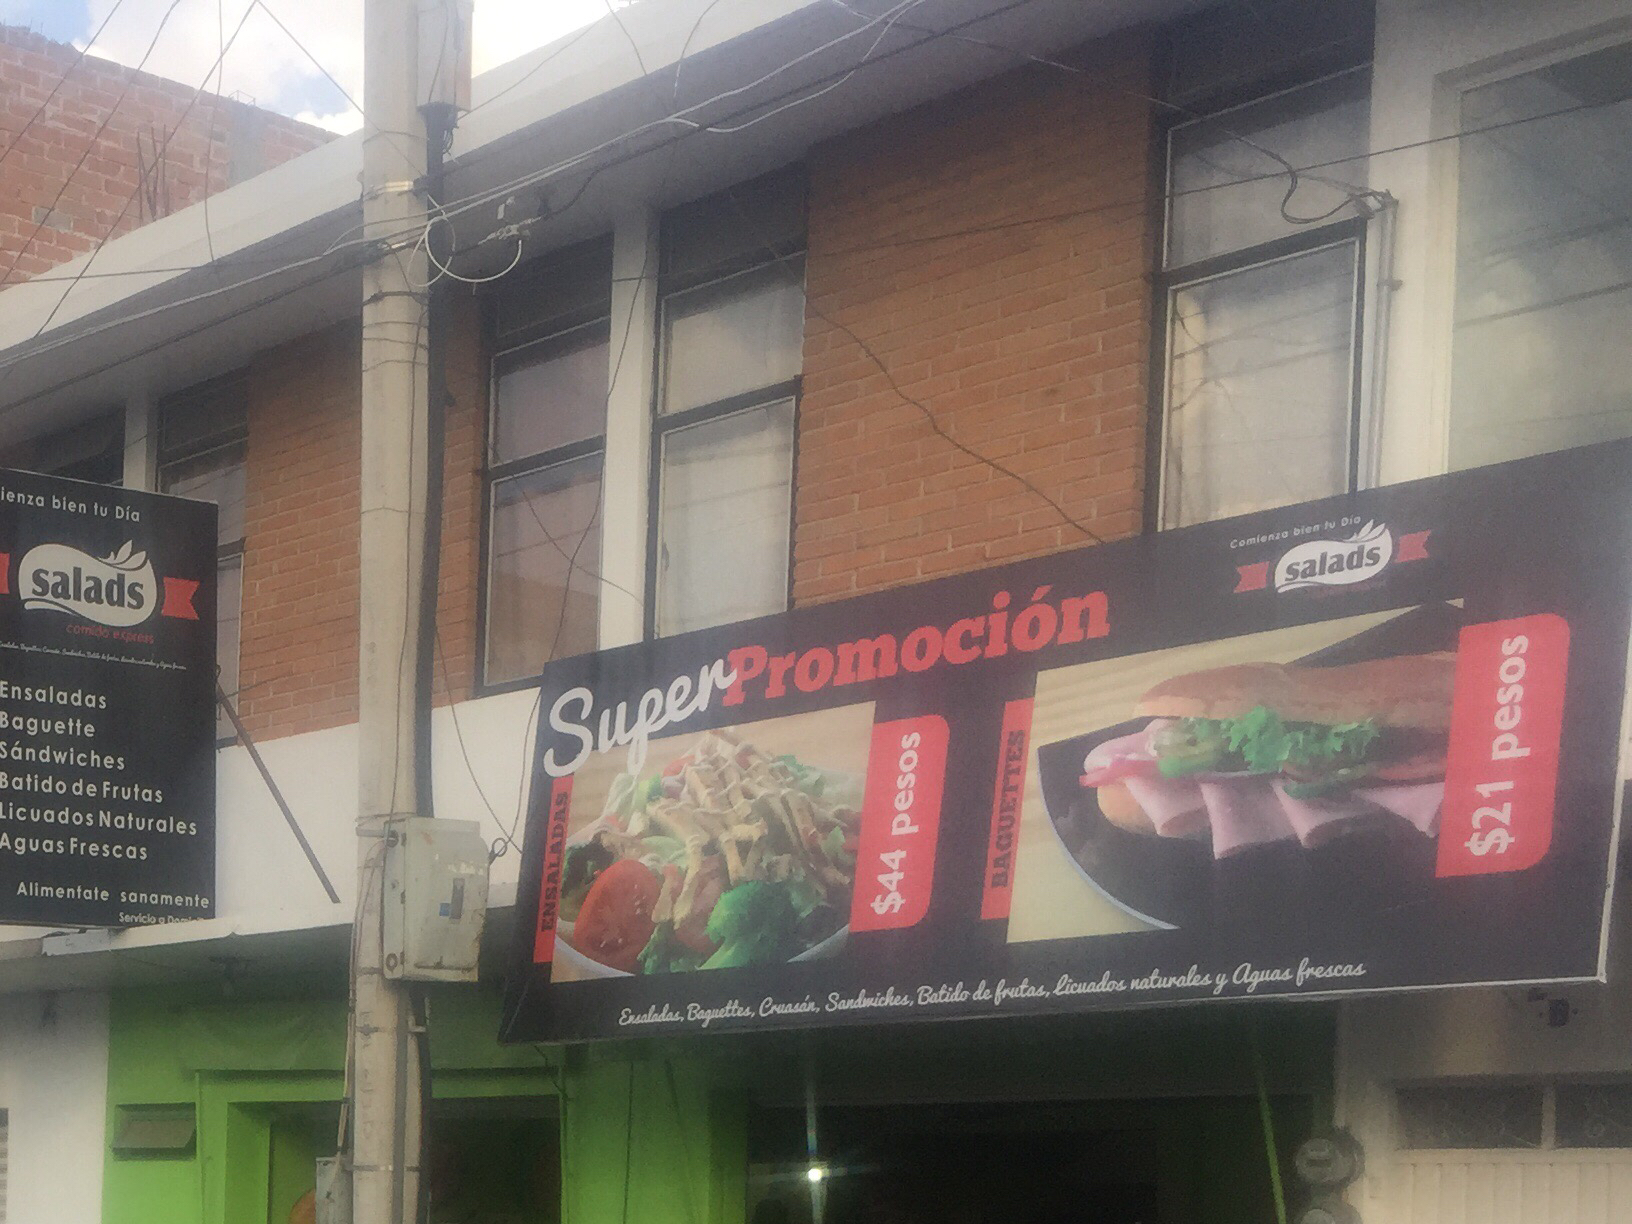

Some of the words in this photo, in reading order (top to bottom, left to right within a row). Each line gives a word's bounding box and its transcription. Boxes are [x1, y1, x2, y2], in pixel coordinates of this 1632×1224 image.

[52, 495, 87, 514] bien
[94, 502, 108, 517] tu
[115, 505, 140, 522] Día
[1230, 532, 1289, 549] Comienza
[1293, 524, 1320, 537] bien
[1324, 521, 1336, 530] tu
[1285, 545, 1381, 582] salads
[31, 567, 145, 610] salads
[0, 680, 107, 709] Ensaladas
[543, 658, 740, 778] Super
[722, 585, 1110, 707] Promoción
[0, 711, 96, 738] Baguette
[1464, 780, 1515, 856] $21
[1491, 634, 1531, 761] pesos
[71, 778, 98, 798] de
[102, 781, 163, 804] Frutas
[98, 810, 197, 836] Naturales
[991, 729, 1025, 889] BAGUETTES
[870, 849, 907, 925] $44
[891, 731, 921, 835] pesos
[69, 837, 148, 861] Frescas
[541, 791, 568, 932] ENSALADAS
[120, 890, 210, 909] sanamente
[118, 912, 156, 924] Servicio
[686, 1000, 755, 1028] Baguettes,
[758, 994, 820, 1018] Cruasán,
[825, 985, 914, 1013] Sandwiches,
[917, 981, 971, 1007] Batido
[972, 980, 992, 1001] de
[994, 978, 1051, 1006] frutas,
[1052, 970, 1125, 997] Licuados
[1130, 964, 1212, 990] naturales
[1215, 976, 1228, 994] y
[1232, 962, 1290, 993] Aguas
[1296, 957, 1367, 987] frescas
